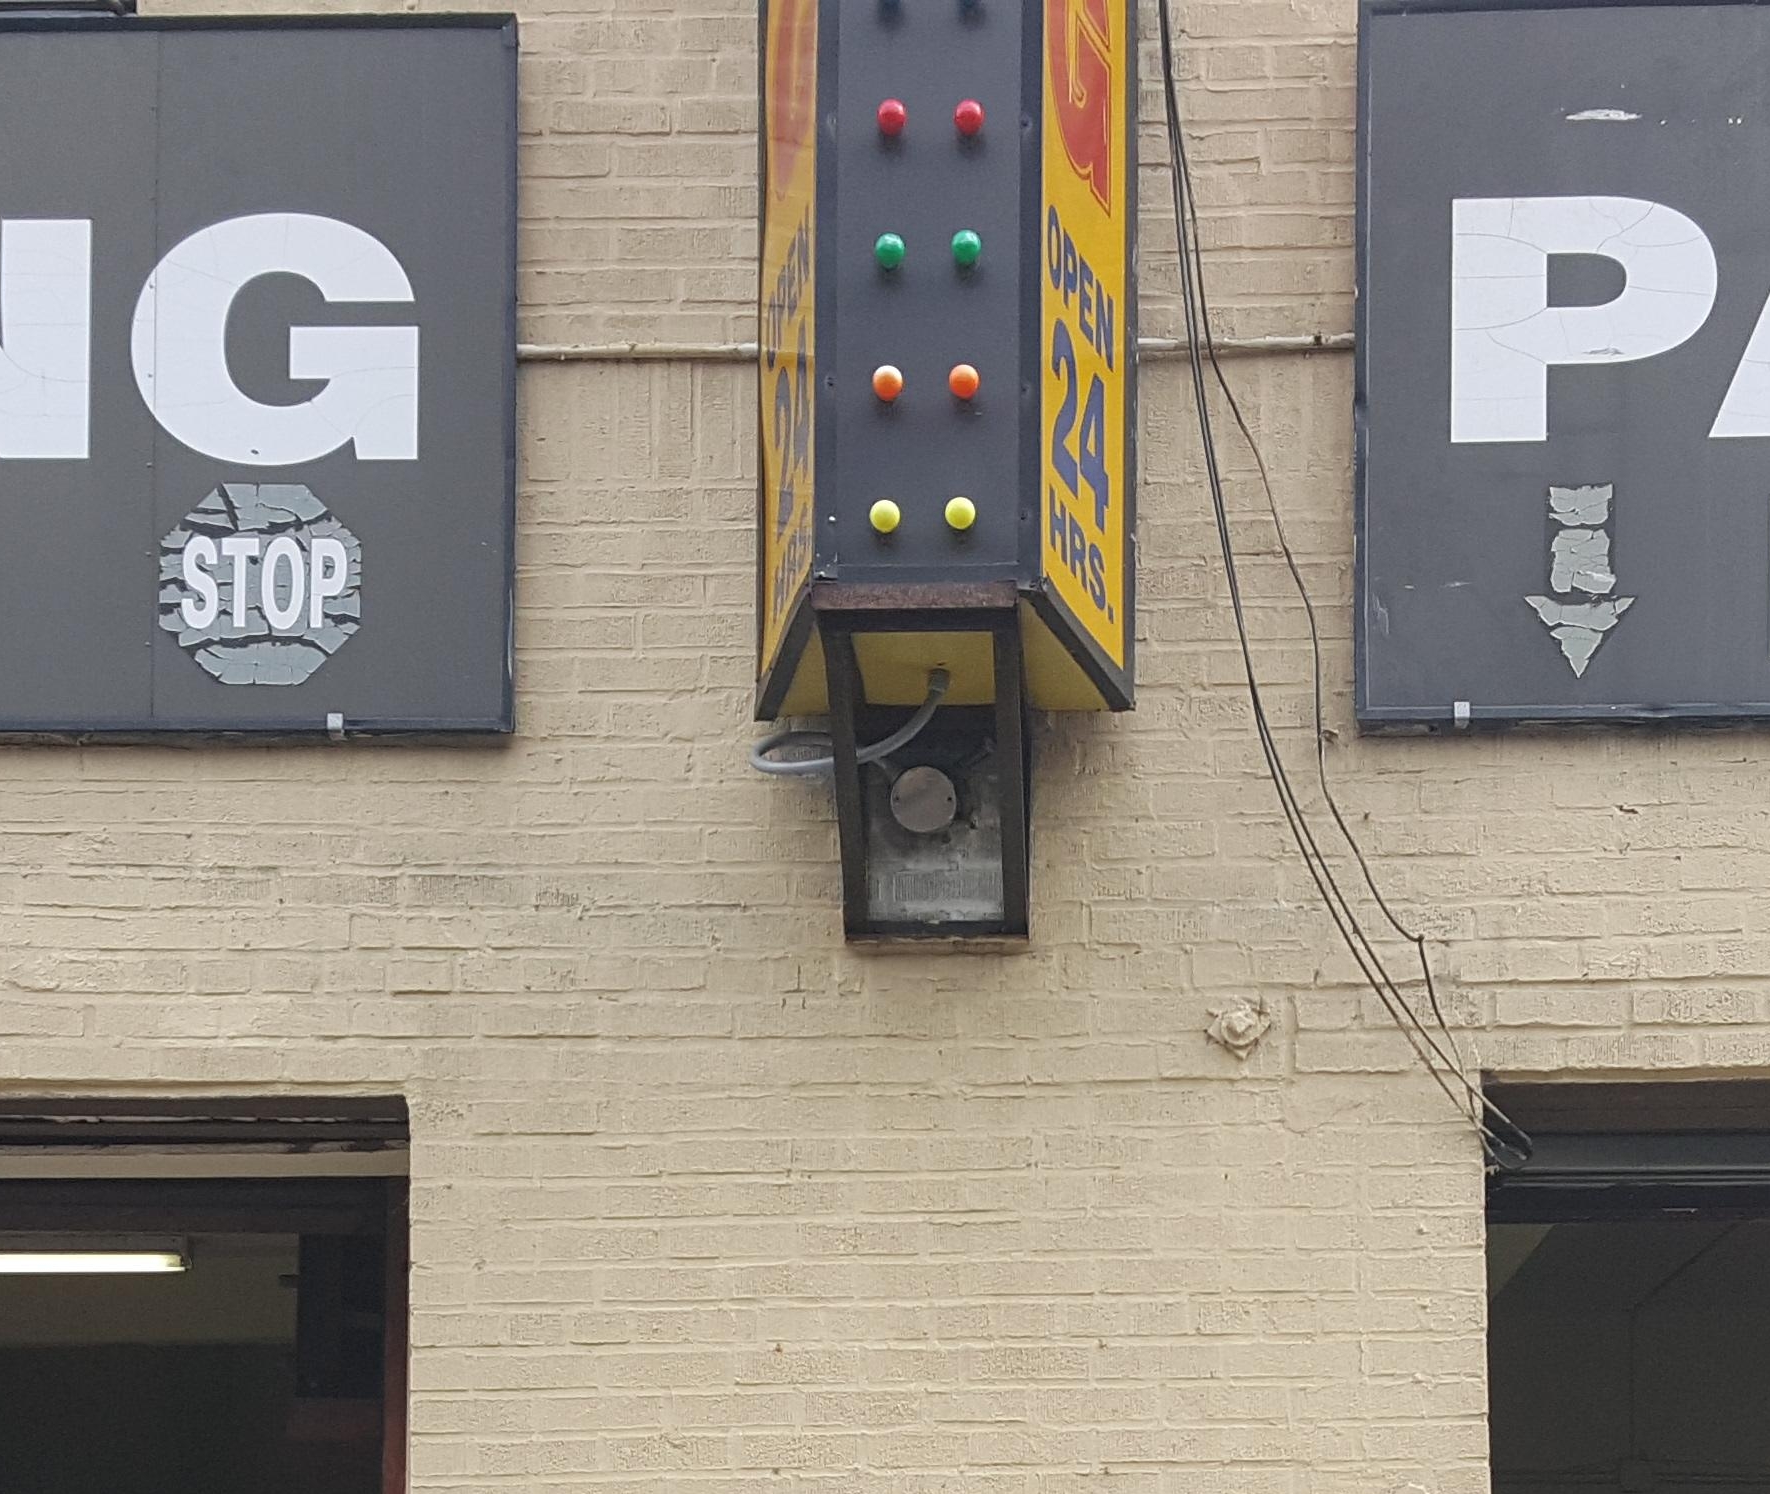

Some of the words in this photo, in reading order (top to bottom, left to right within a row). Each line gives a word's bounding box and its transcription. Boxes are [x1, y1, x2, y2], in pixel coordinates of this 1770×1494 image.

[1047, 204, 1114, 373] OPEN
[1051, 318, 1109, 535] 24
[180, 535, 349, 630] STOP
[1049, 483, 1114, 625] HRS.
